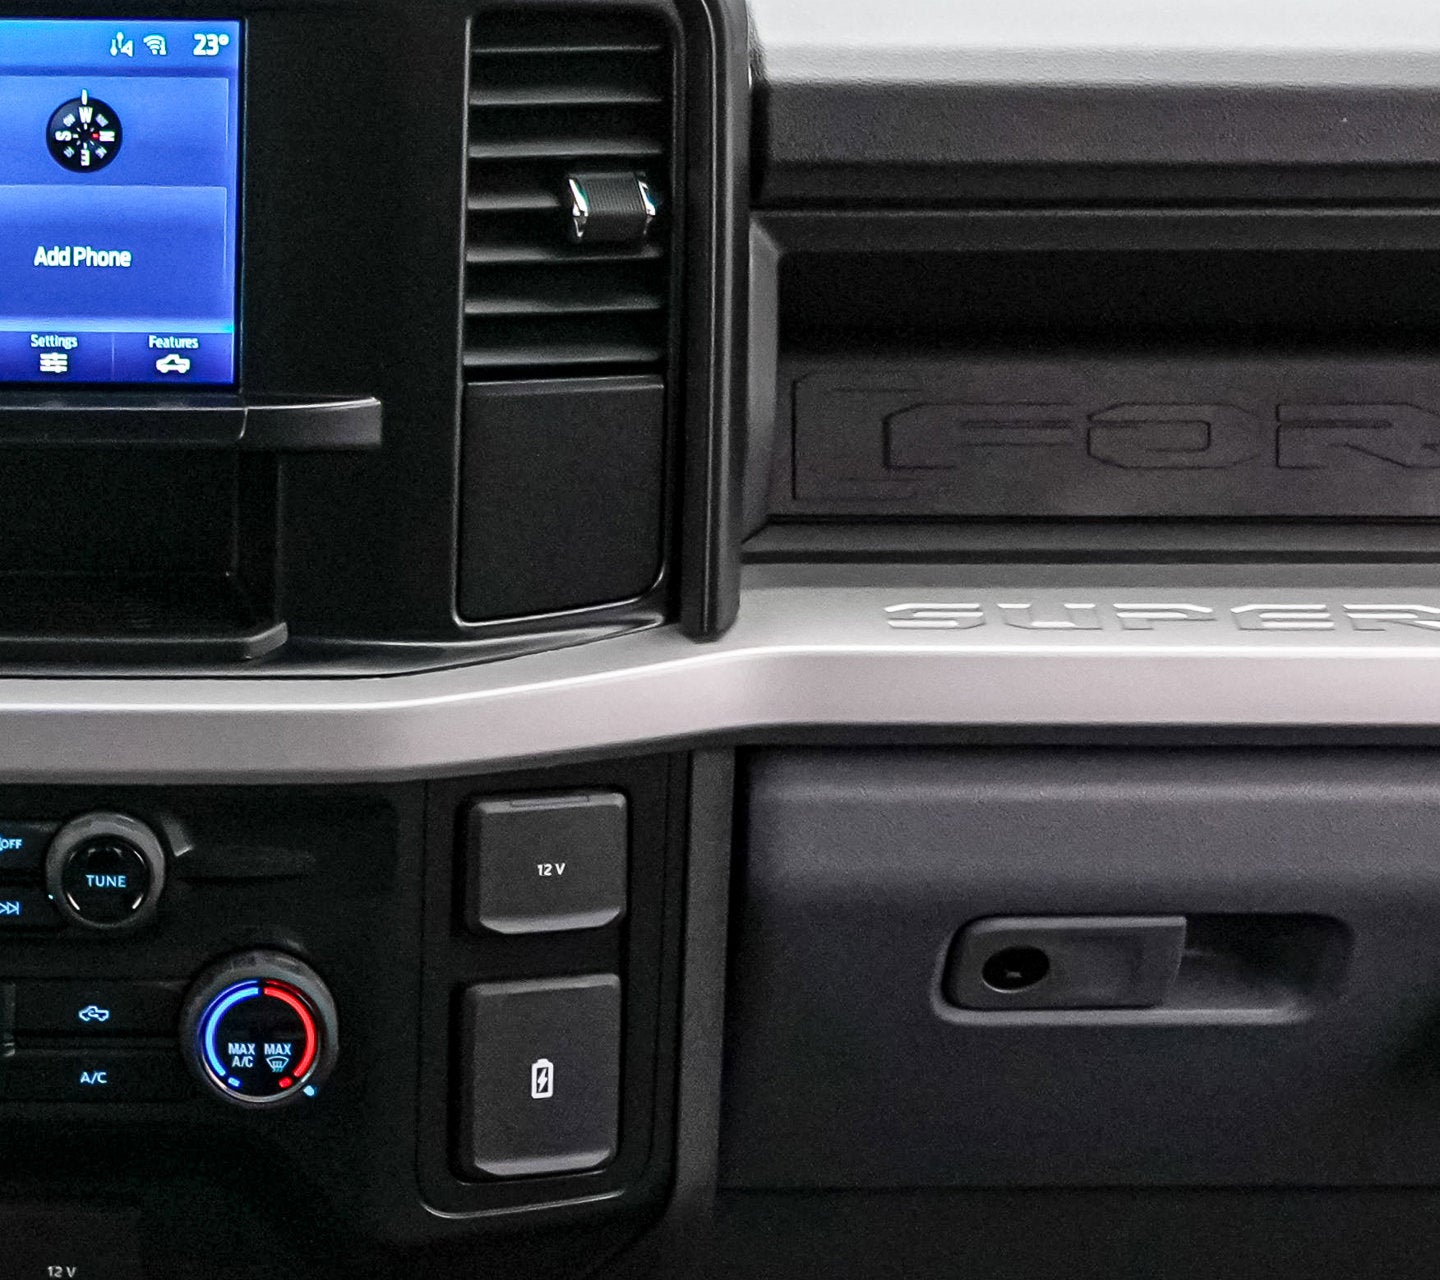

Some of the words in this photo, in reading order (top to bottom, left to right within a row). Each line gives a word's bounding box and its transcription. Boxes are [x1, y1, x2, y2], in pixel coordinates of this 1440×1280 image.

[193, 33, 229, 57] 23°
[79, 106, 93, 124] W
[34, 246, 70, 268] Add
[74, 246, 132, 268] Phone
[30, 335, 78, 352] Settings
[148, 335, 199, 350] Features
[1, 837, 23, 850] OFF
[537, 863, 553, 877] 12
[555, 862, 566, 877] V
[86, 874, 127, 888] TUNE
[228, 1043, 256, 1057] MAX
[264, 1043, 292, 1057] MAX
[232, 1055, 255, 1069] A/C
[80, 1070, 108, 1085] A/C
[47, 1265, 63, 1279] 12
[65, 1264, 77, 1278] V
